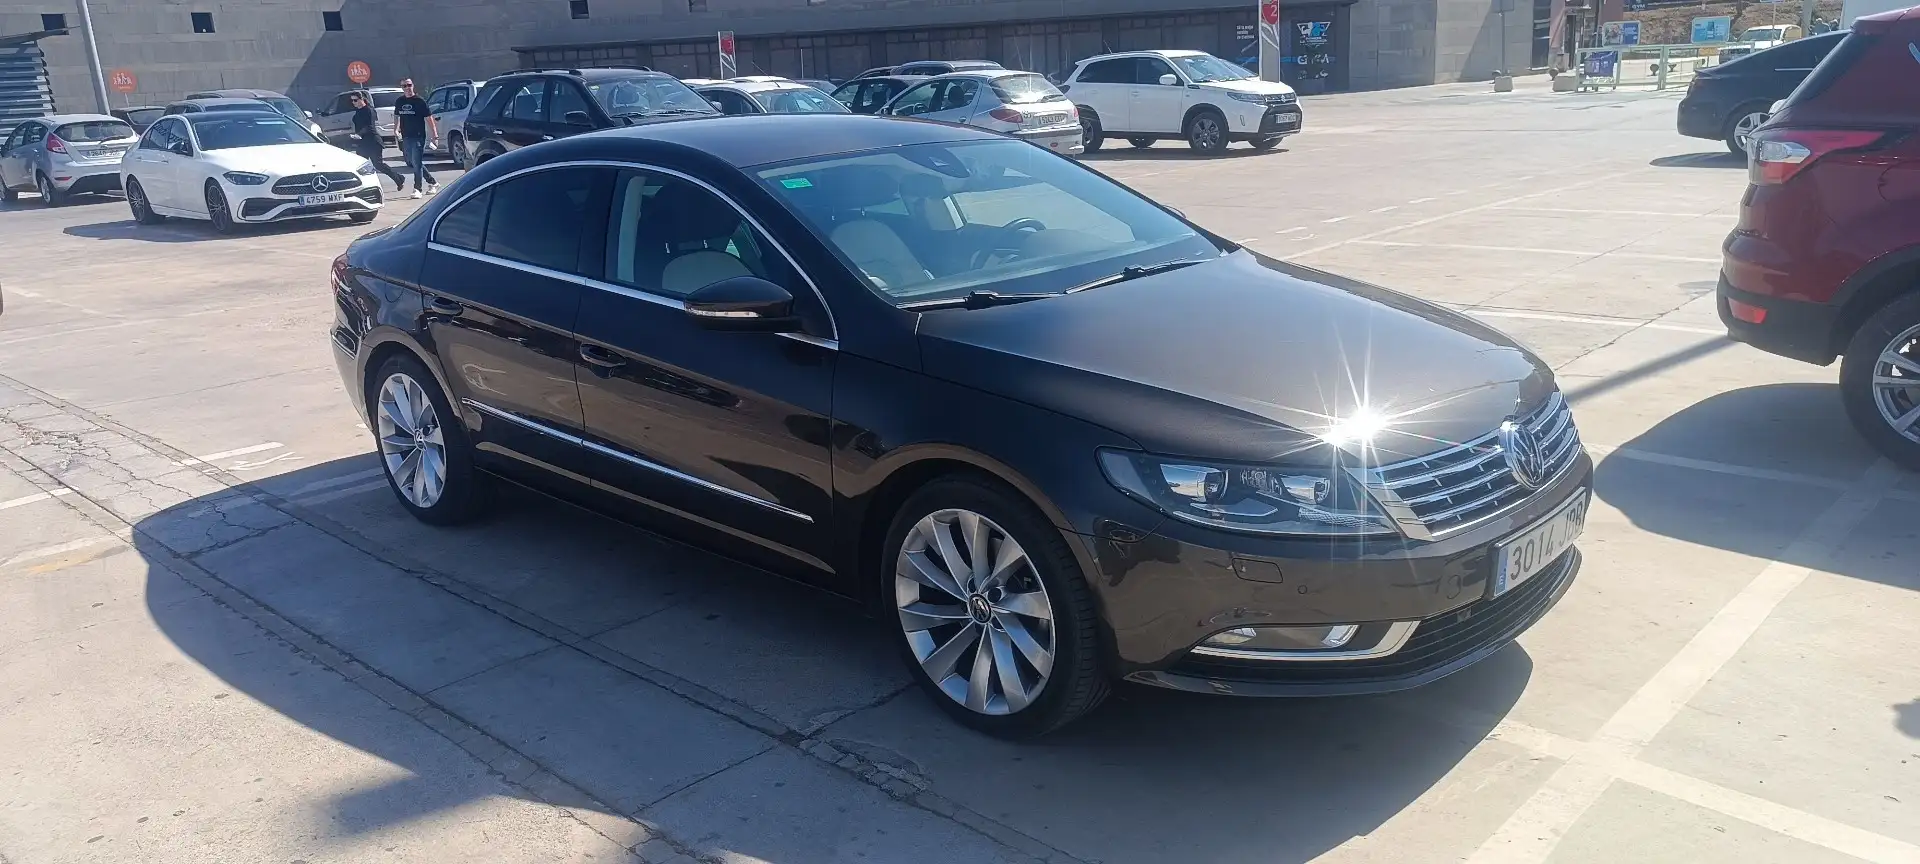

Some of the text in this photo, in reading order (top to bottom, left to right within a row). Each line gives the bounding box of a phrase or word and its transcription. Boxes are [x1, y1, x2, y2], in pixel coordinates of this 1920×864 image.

[1270, 5, 1278, 17] 2
[306, 195, 326, 204] 4759
[1510, 523, 1555, 581] 3014
